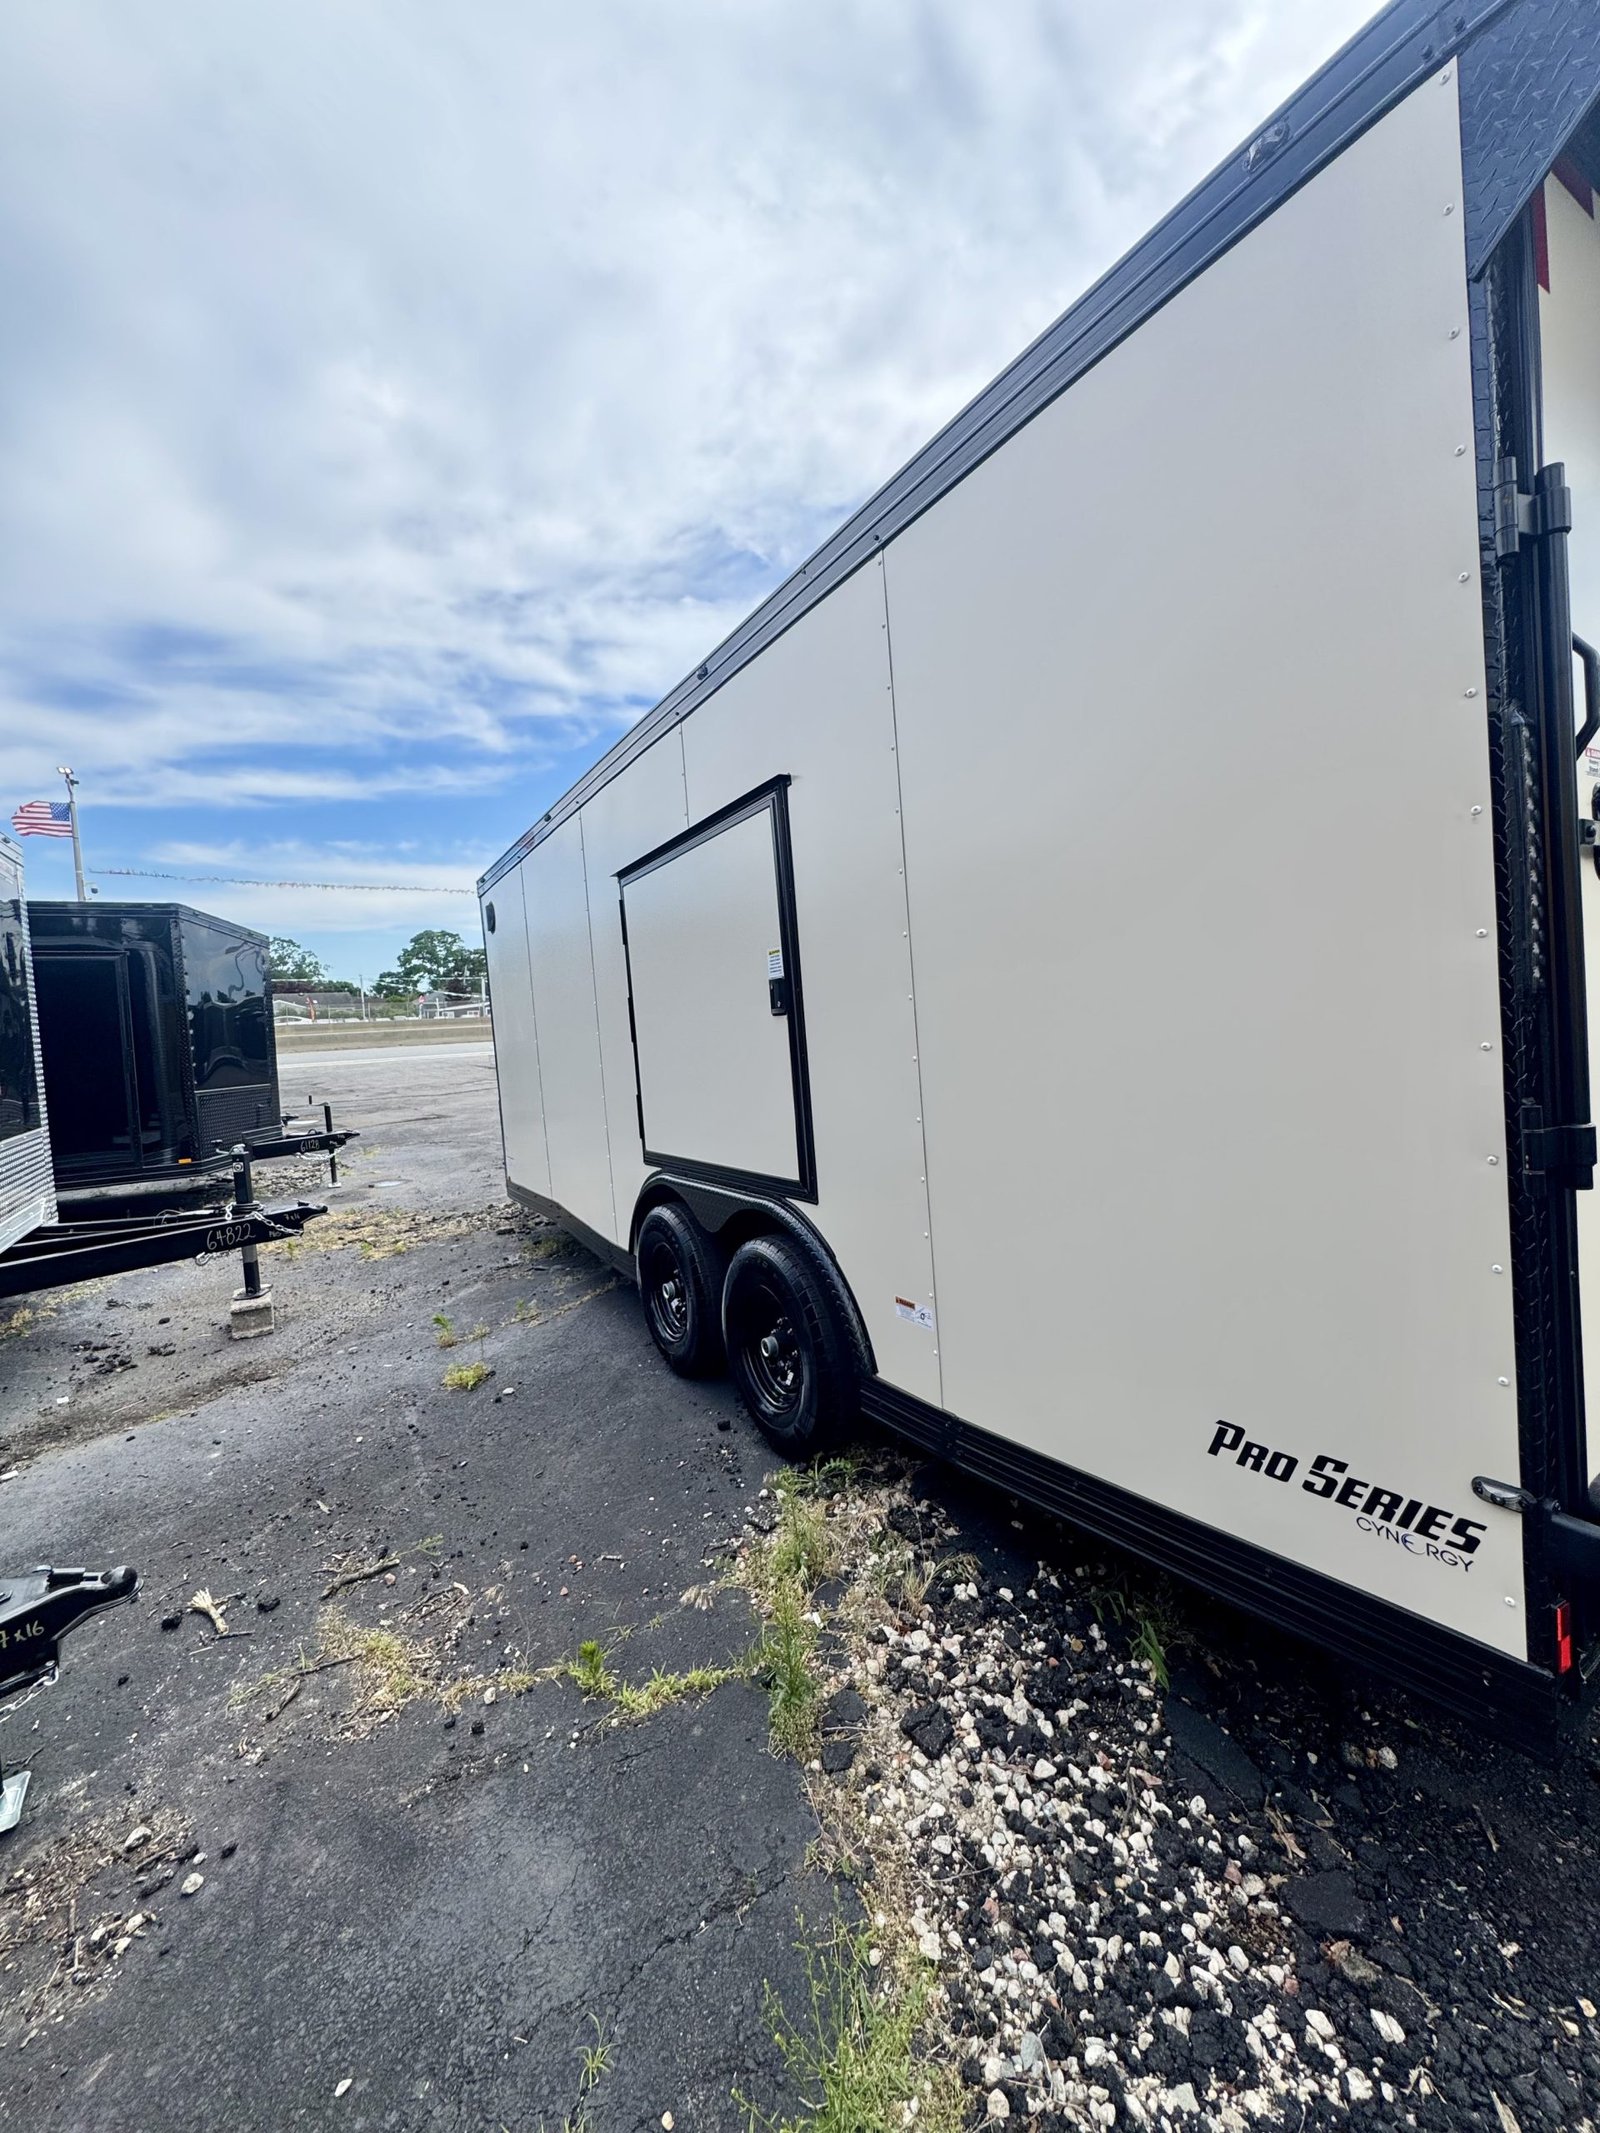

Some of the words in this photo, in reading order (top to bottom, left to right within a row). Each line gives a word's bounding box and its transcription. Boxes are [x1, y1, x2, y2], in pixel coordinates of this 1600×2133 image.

[206, 1223, 256, 1250] 64822
[1302, 1454, 1488, 1554] SERIES
[1356, 1516, 1474, 1572] CYNERGY
